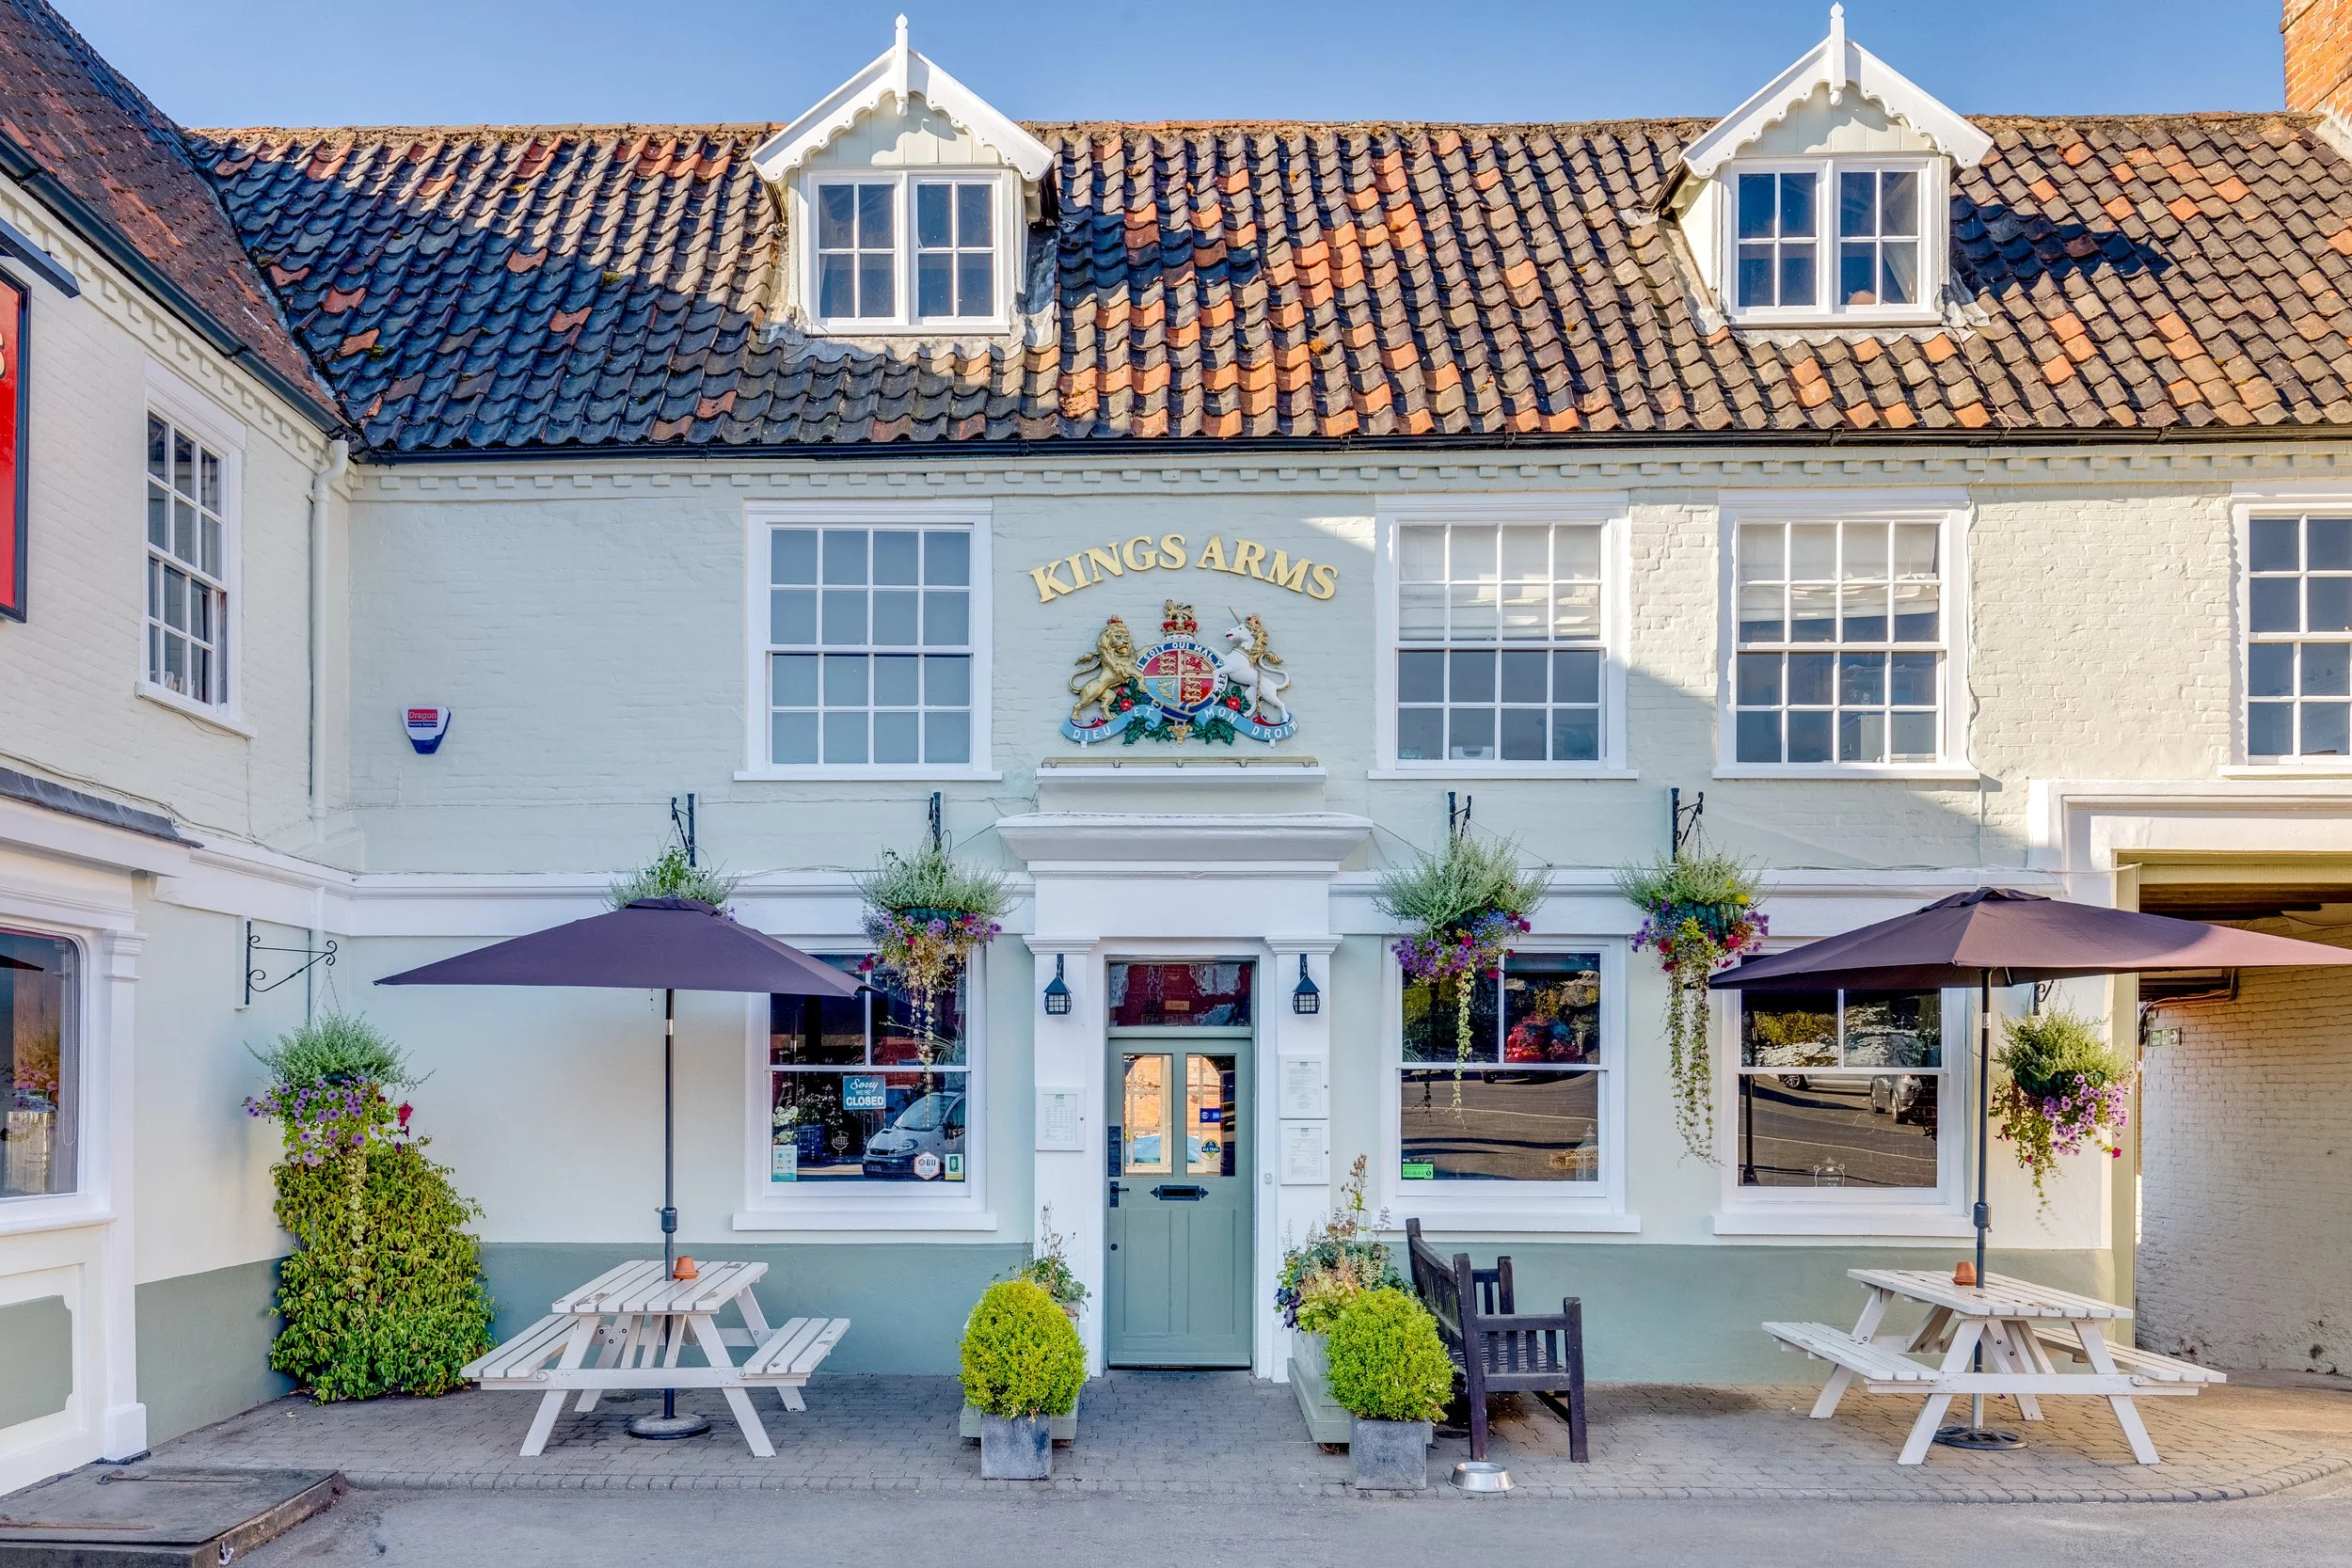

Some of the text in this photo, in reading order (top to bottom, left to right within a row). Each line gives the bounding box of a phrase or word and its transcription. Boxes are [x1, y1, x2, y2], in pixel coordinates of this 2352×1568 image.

[1028, 533, 1339, 603] KINGS ARMS
[1145, 645, 1166, 660] SOIT
[1194, 644, 1213, 660] MAL
[409, 711, 437, 720] Dragon
[1073, 705, 1298, 741] DIEU ET MON DROIT
[850, 1078, 879, 1092] Sorry
[846, 1096, 884, 1106] CLOSED
